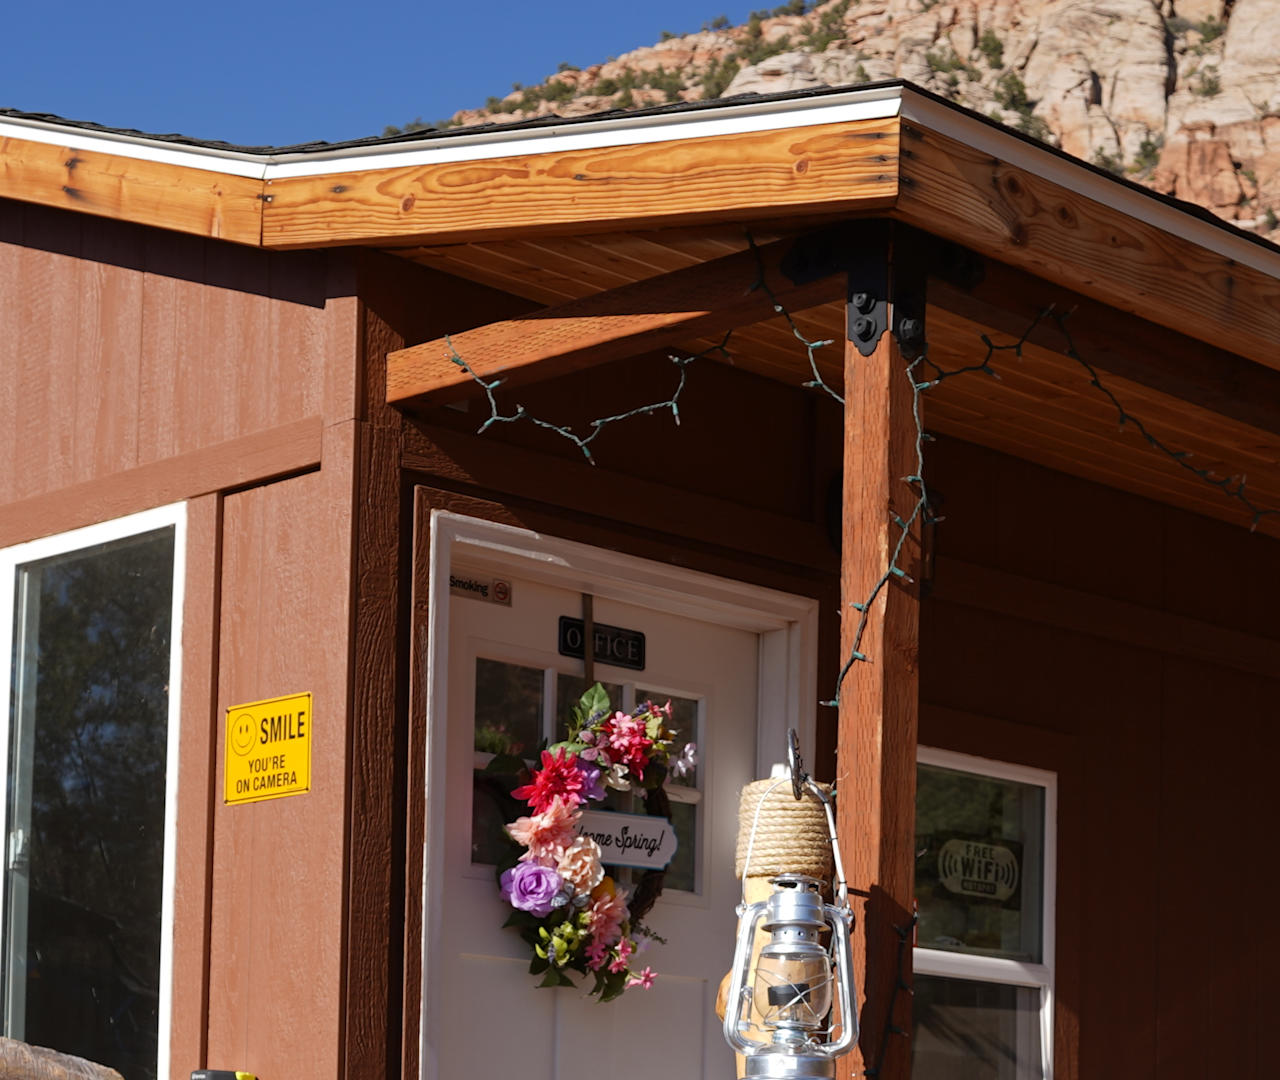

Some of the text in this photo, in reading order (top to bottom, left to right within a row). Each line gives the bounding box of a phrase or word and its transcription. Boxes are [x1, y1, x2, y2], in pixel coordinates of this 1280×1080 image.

[450, 576, 488, 597] Smoking
[566, 627, 640, 661] OFICE
[260, 711, 305, 745] SMILE
[248, 754, 286, 774] YOU'RE
[236, 770, 297, 794] ON CAMERA
[615, 826, 665, 858] Spring!
[965, 843, 994, 861] FREE
[961, 856, 999, 883] WiFi
